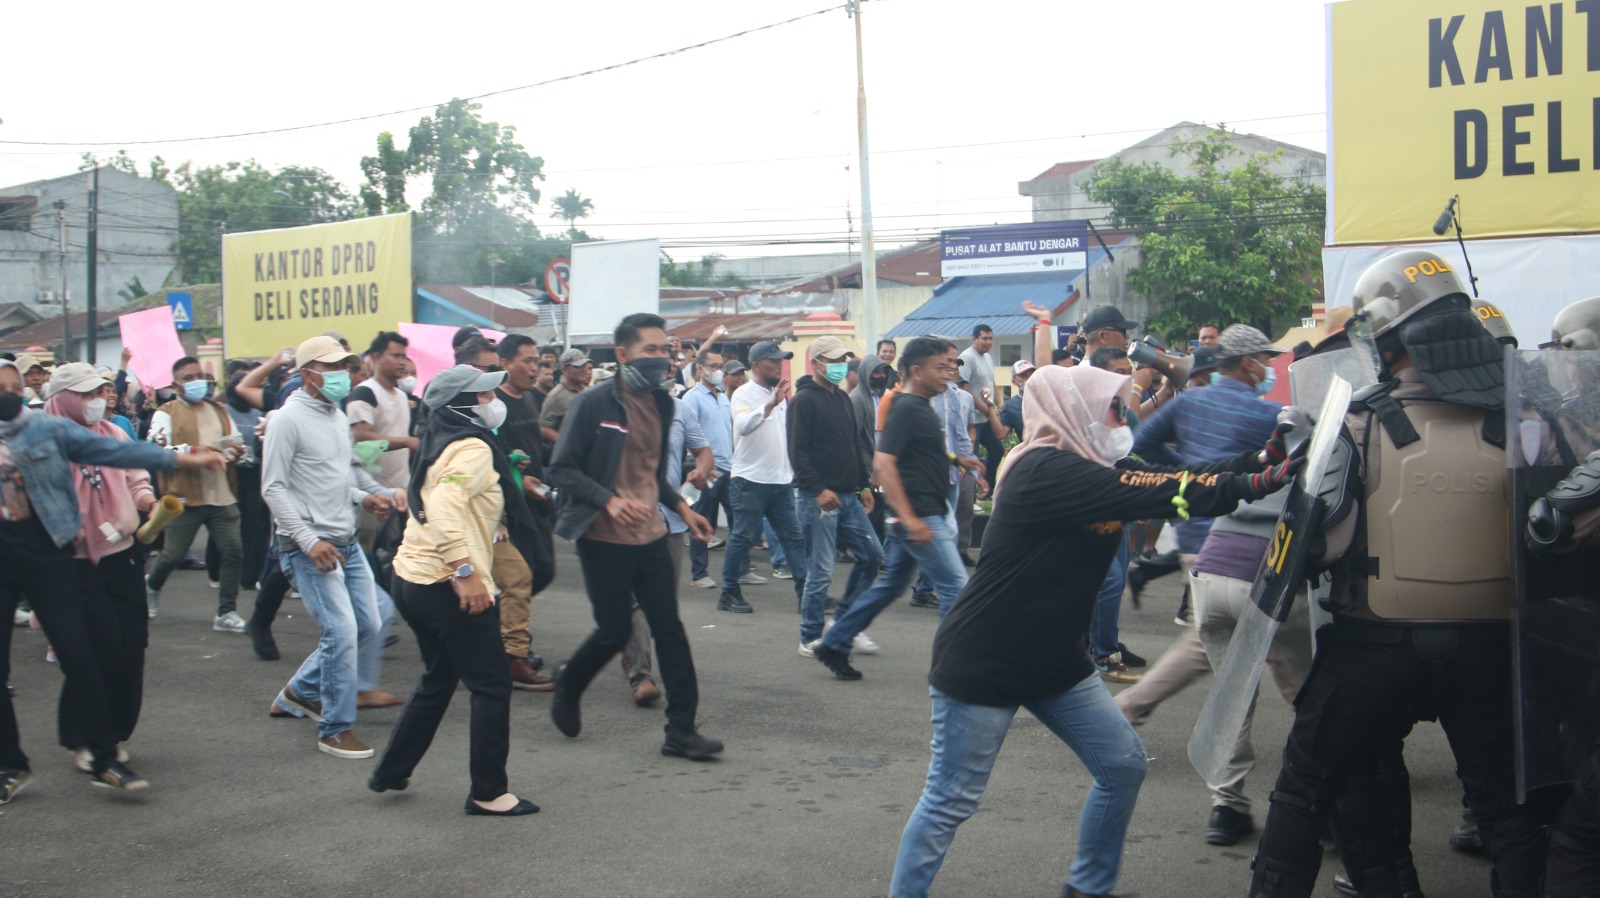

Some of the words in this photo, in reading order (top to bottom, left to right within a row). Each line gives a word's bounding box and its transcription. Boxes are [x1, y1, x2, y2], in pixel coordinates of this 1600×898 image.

[255, 247, 323, 282] KANTOR
[332, 240, 376, 276] DPRD
[945, 244, 976, 257] PUSAT
[978, 242, 1002, 254] ALAT
[1004, 240, 1037, 252] BANTU
[1039, 237, 1079, 249] DENGAR
[254, 290, 292, 321] DELI
[300, 282, 379, 319] SERDANG
[1411, 472, 1495, 495] POLISI
